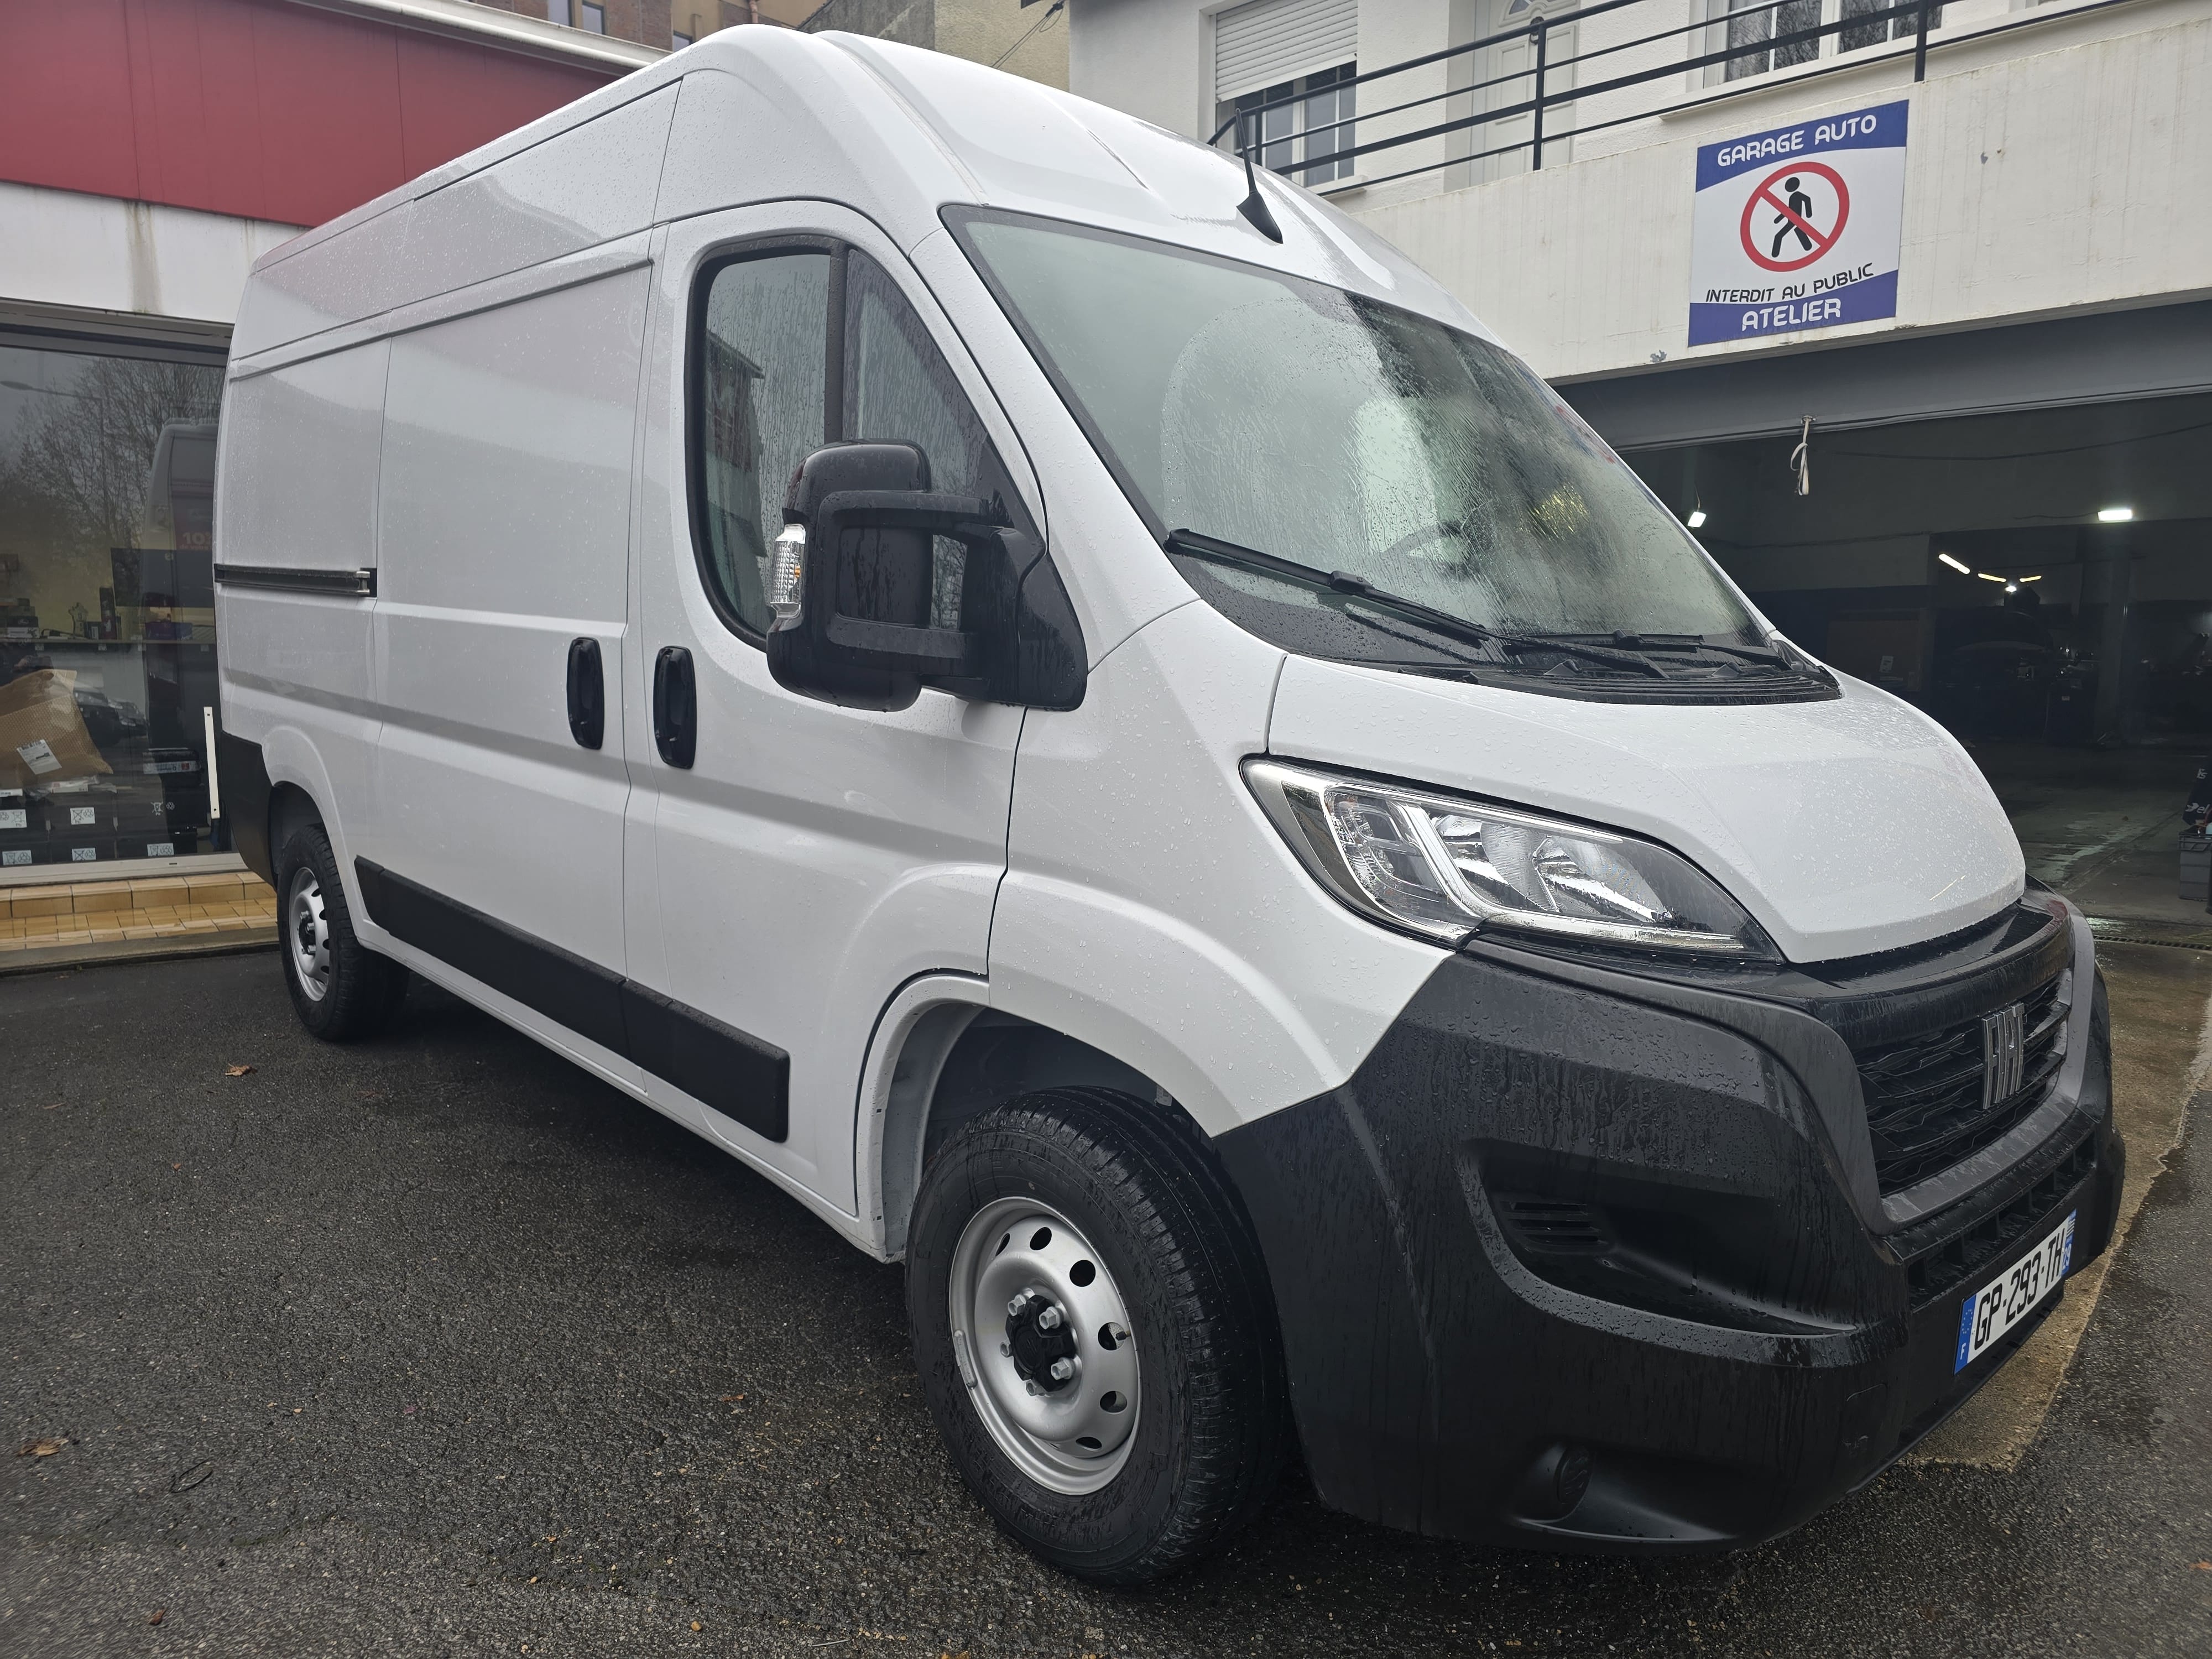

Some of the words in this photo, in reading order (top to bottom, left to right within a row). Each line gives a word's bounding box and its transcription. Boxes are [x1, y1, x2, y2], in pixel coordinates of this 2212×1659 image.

[1717, 130, 1804, 166] GARAGE
[1814, 114, 1876, 145] AUTO
[1705, 288, 1775, 302] INTERDIT
[1782, 283, 1805, 300] AU
[1813, 262, 1874, 294] PUBLIC
[1742, 298, 1841, 331] ATELIER
[1982, 1002, 2025, 1110] FIAT
[1974, 1228, 2065, 1350] GP-293-TH
[1960, 1342, 1966, 1360] F
